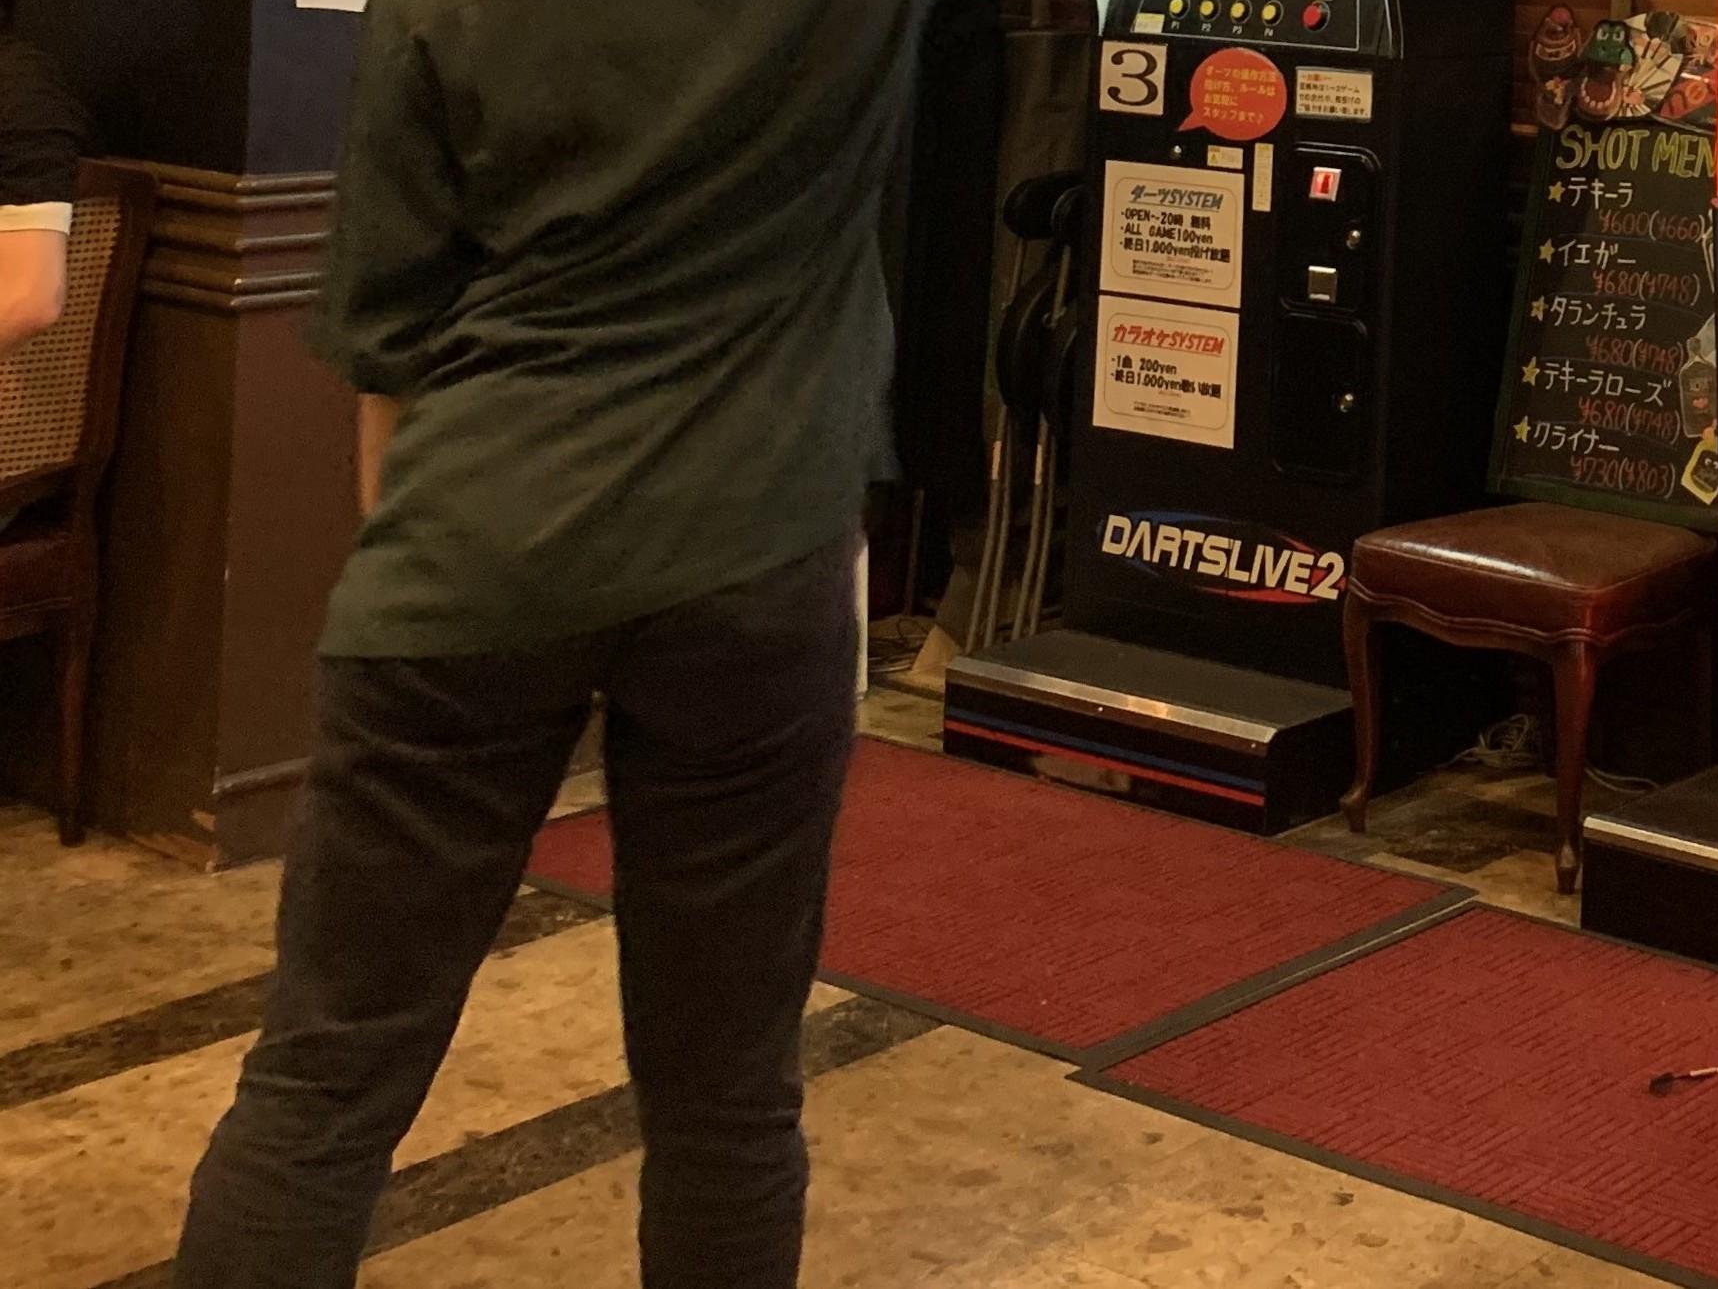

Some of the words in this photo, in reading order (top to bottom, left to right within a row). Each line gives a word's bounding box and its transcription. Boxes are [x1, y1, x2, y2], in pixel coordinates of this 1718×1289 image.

[1106, 49, 1159, 107] 3
[1556, 124, 1650, 171] SHOT
[1567, 177, 1634, 210] テキーラ
[1124, 224, 1143, 236] ALL
[1558, 238, 1637, 270] イエガー
[1550, 295, 1647, 331] タランチュラ
[1543, 359, 1673, 408] テキーラローズ
[1533, 421, 1621, 455] クライナー
[1101, 513, 1345, 600] DARTSLIVE2
